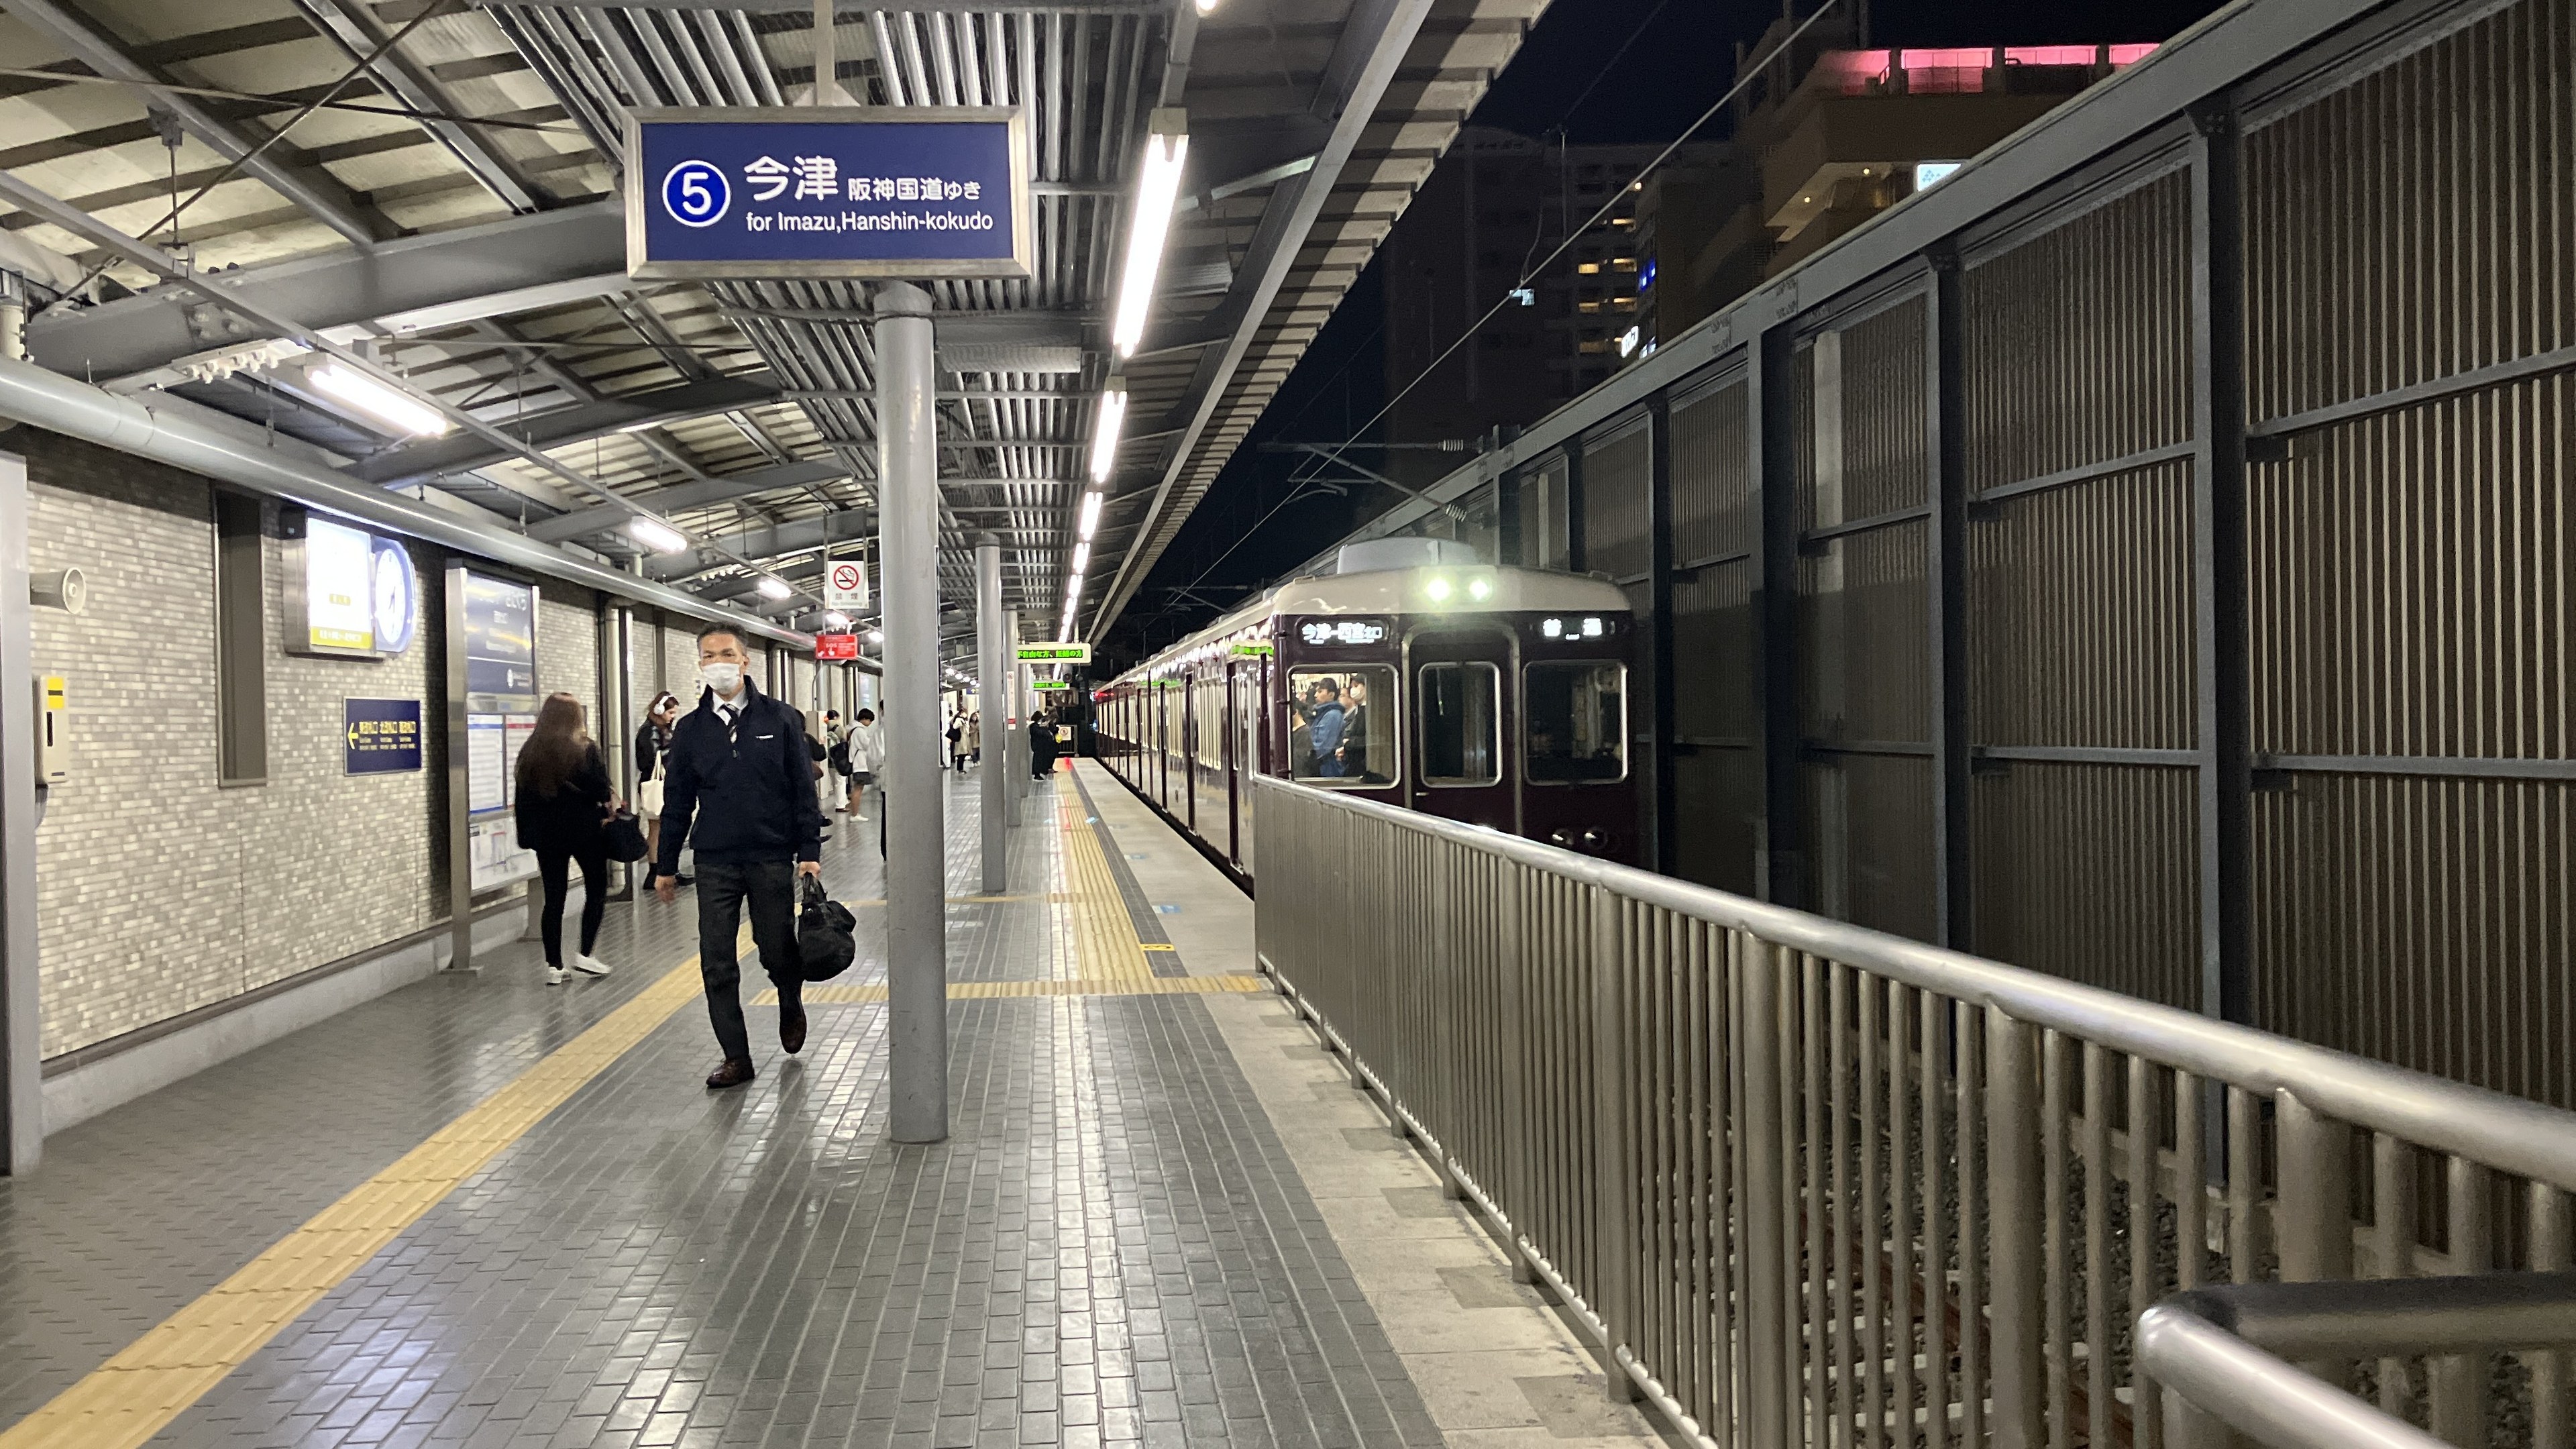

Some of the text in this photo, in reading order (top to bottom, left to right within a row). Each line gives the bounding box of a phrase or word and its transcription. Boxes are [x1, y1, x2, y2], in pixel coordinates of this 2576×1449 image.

[682, 172, 712, 215] 5
[744, 155, 981, 201] 今津 阪神国道ゆき
[745, 211, 773, 231] for
